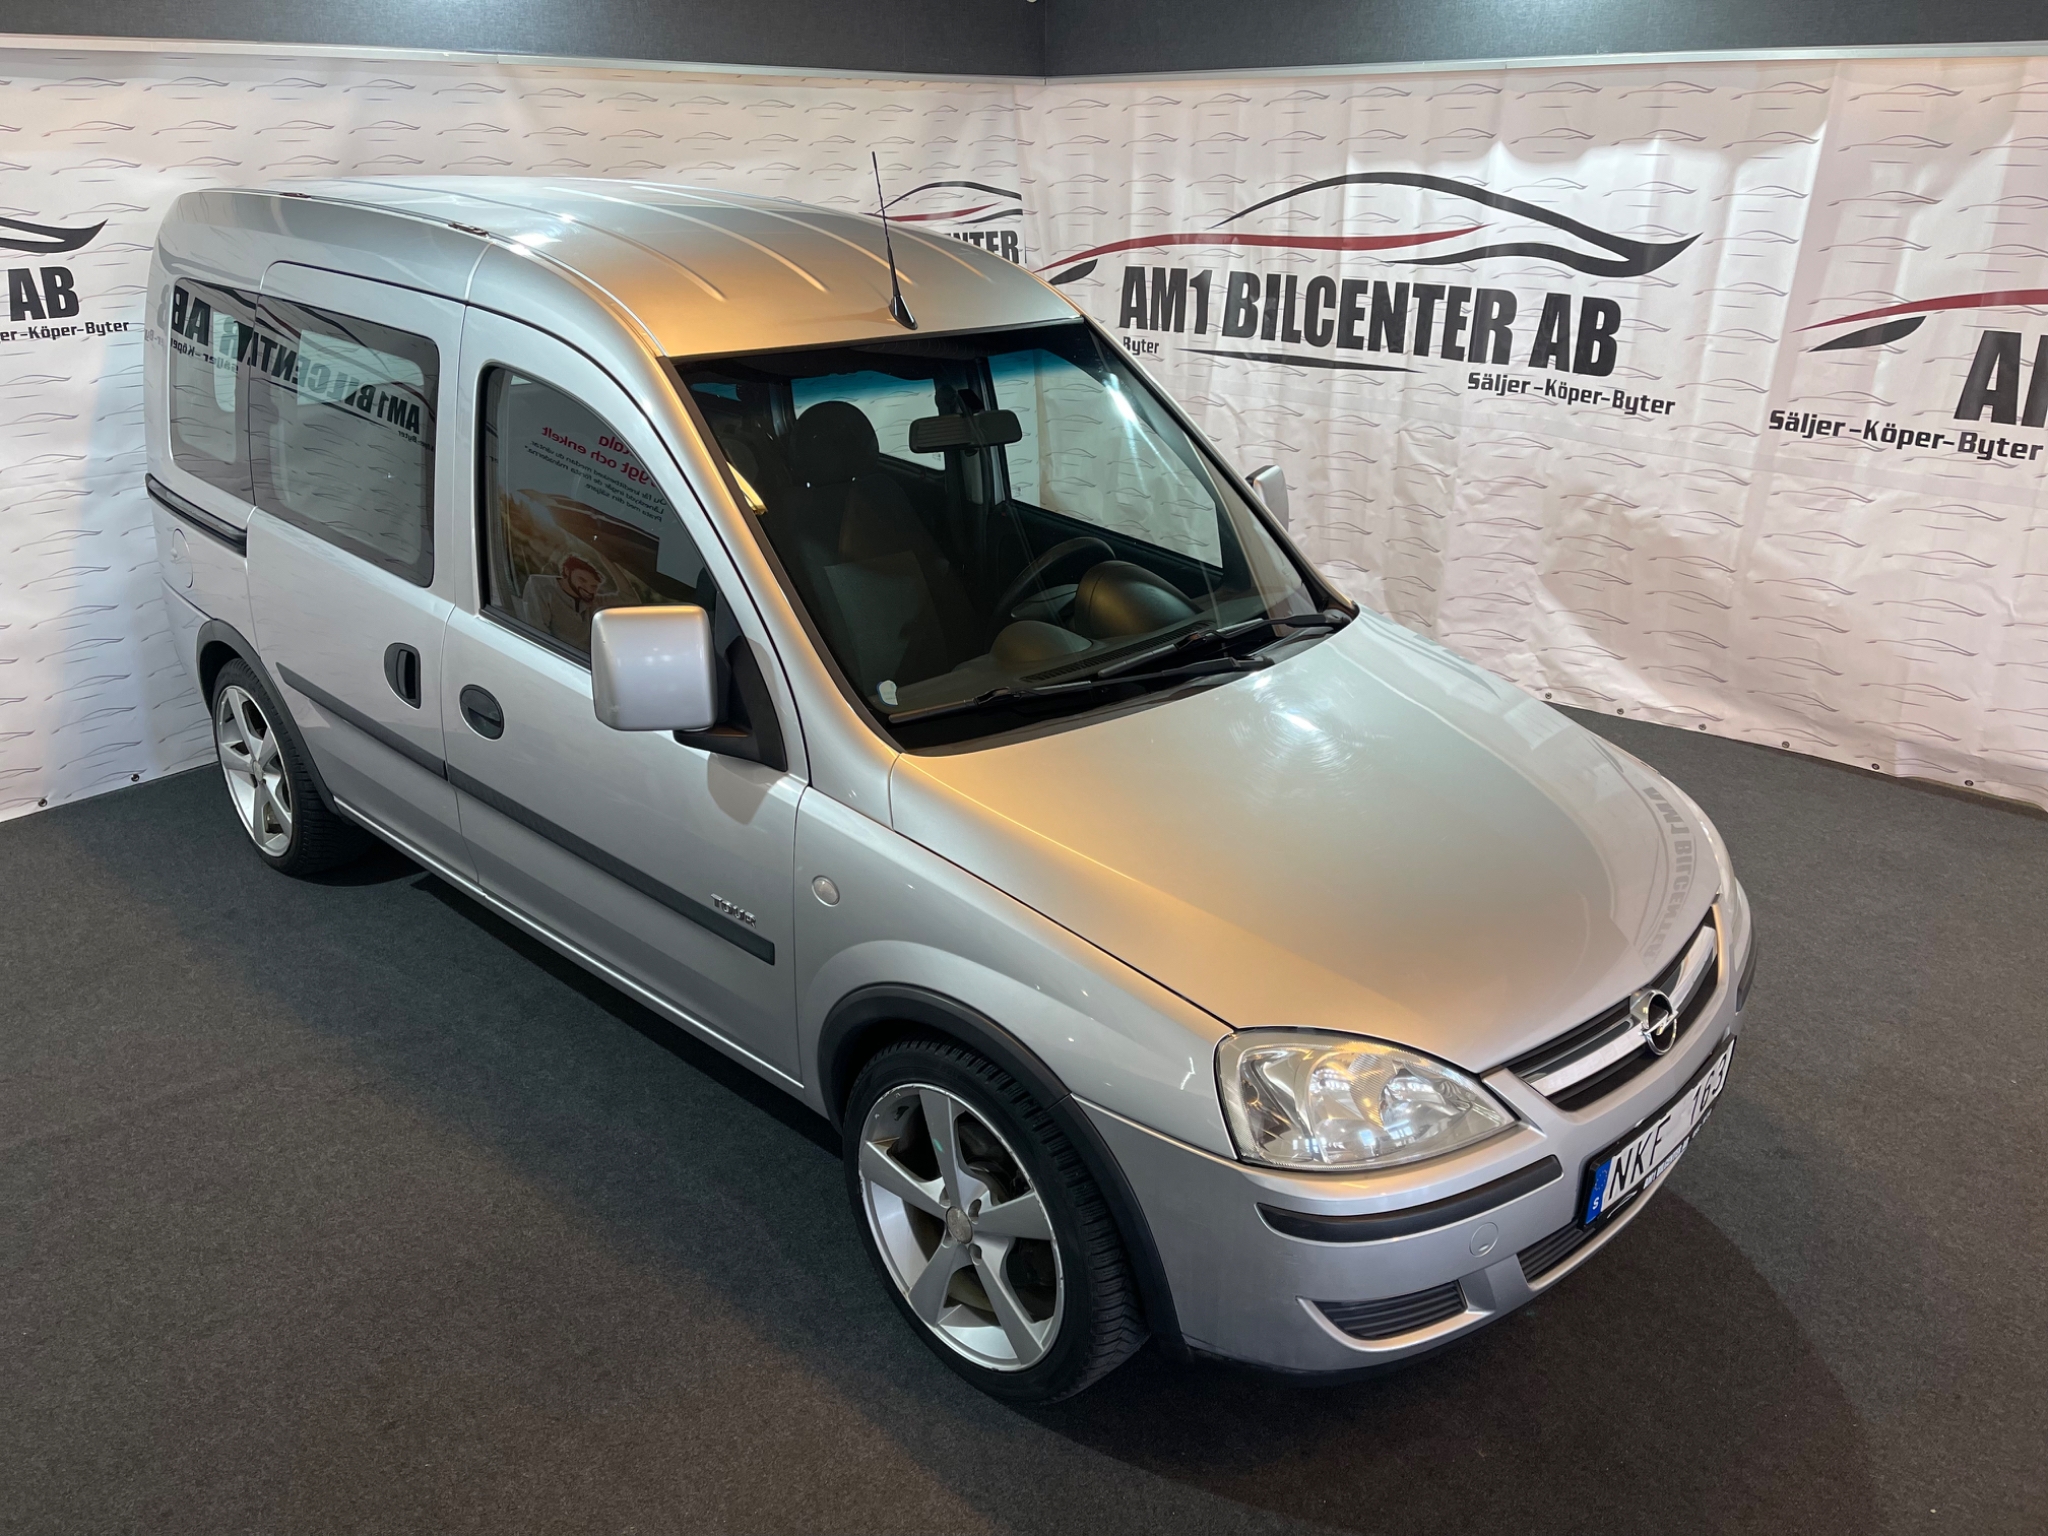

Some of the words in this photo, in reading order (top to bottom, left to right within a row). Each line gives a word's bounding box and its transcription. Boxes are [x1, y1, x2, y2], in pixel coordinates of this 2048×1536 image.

[943, 230, 1020, 264] TER
[8, 266, 80, 321] AB
[1119, 266, 1213, 335] AM1
[1221, 270, 1518, 366] BILCENTER
[1528, 293, 1622, 377] AB
[711, 893, 757, 929] TOUR
[1608, 1114, 1672, 1201] NKF
[1690, 1053, 1728, 1126] 163
[1592, 1196, 1600, 1210] S
